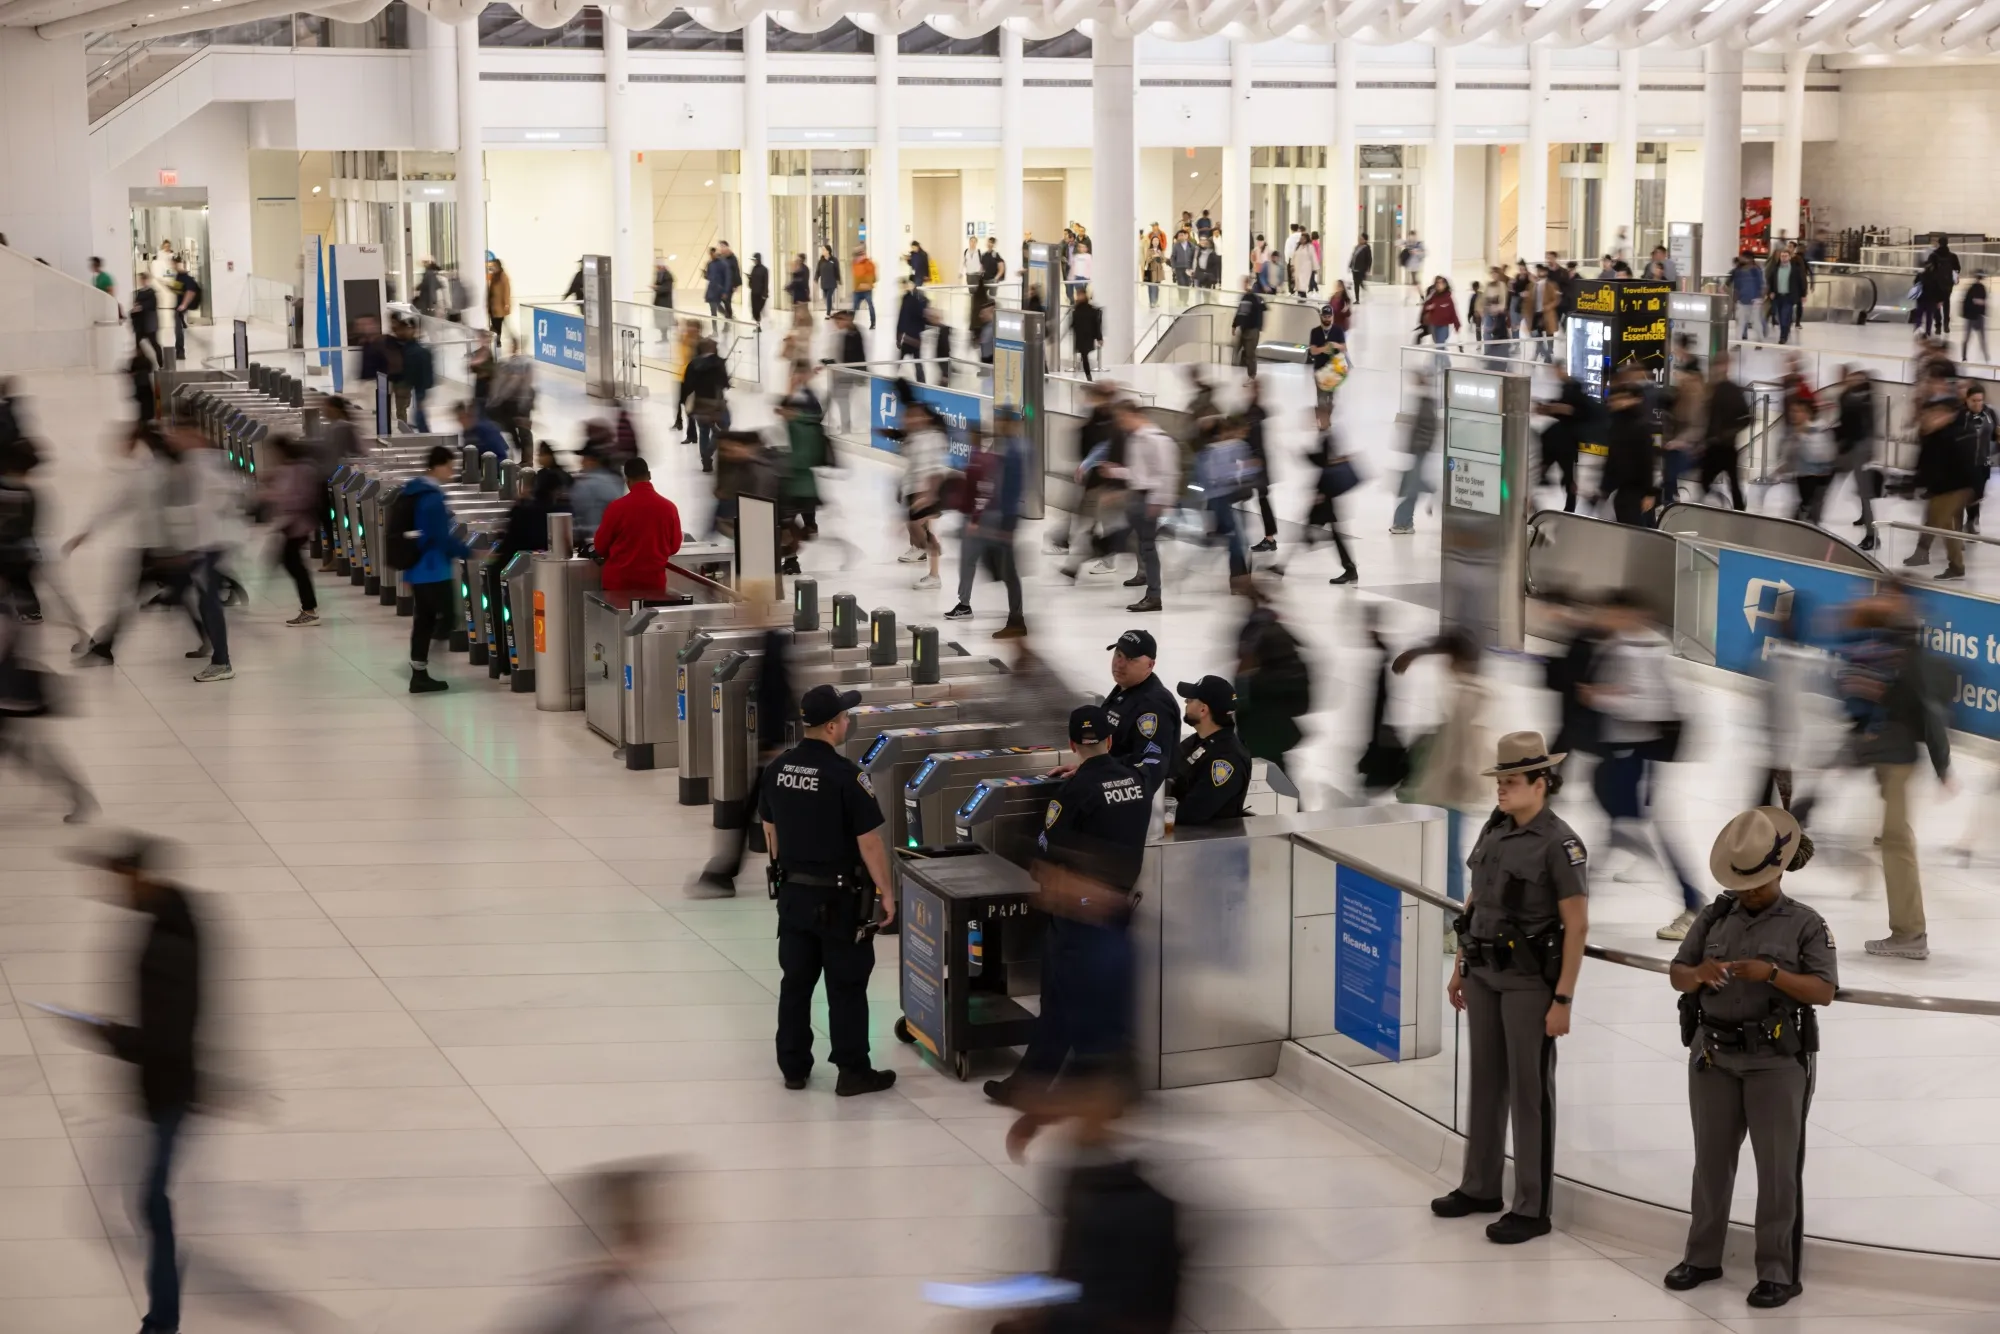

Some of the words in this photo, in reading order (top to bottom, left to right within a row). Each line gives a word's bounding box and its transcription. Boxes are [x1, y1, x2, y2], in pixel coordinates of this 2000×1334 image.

[1580, 291, 1597, 300] Travel
[1577, 297, 1610, 311] Essentials
[565, 327, 576, 342] Trains
[1623, 333, 1665, 341] Essentials
[541, 343, 556, 358] PATH
[563, 346, 572, 359] New
[573, 348, 585, 366] Jersey
[958, 412, 967, 430] to
[949, 437, 972, 463] Jersey
[1455, 475, 1464, 483] Exit
[1465, 476, 1470, 484] to
[1471, 477, 1484, 487] Street
[1455, 486, 1469, 495] Upper
[1470, 489, 1484, 498] Levels
[1455, 497, 1473, 508] Subway
[783, 764, 795, 772] PORT
[794, 766, 818, 775] AUTHORITY
[776, 773, 819, 791] POLICE
[1102, 781, 1113, 790] PORT
[1112, 777, 1135, 788] AUTHORITY
[1104, 785, 1144, 805] POLICE
[1342, 932, 1371, 954] Ricardo
[1372, 945, 1380, 958] B.
